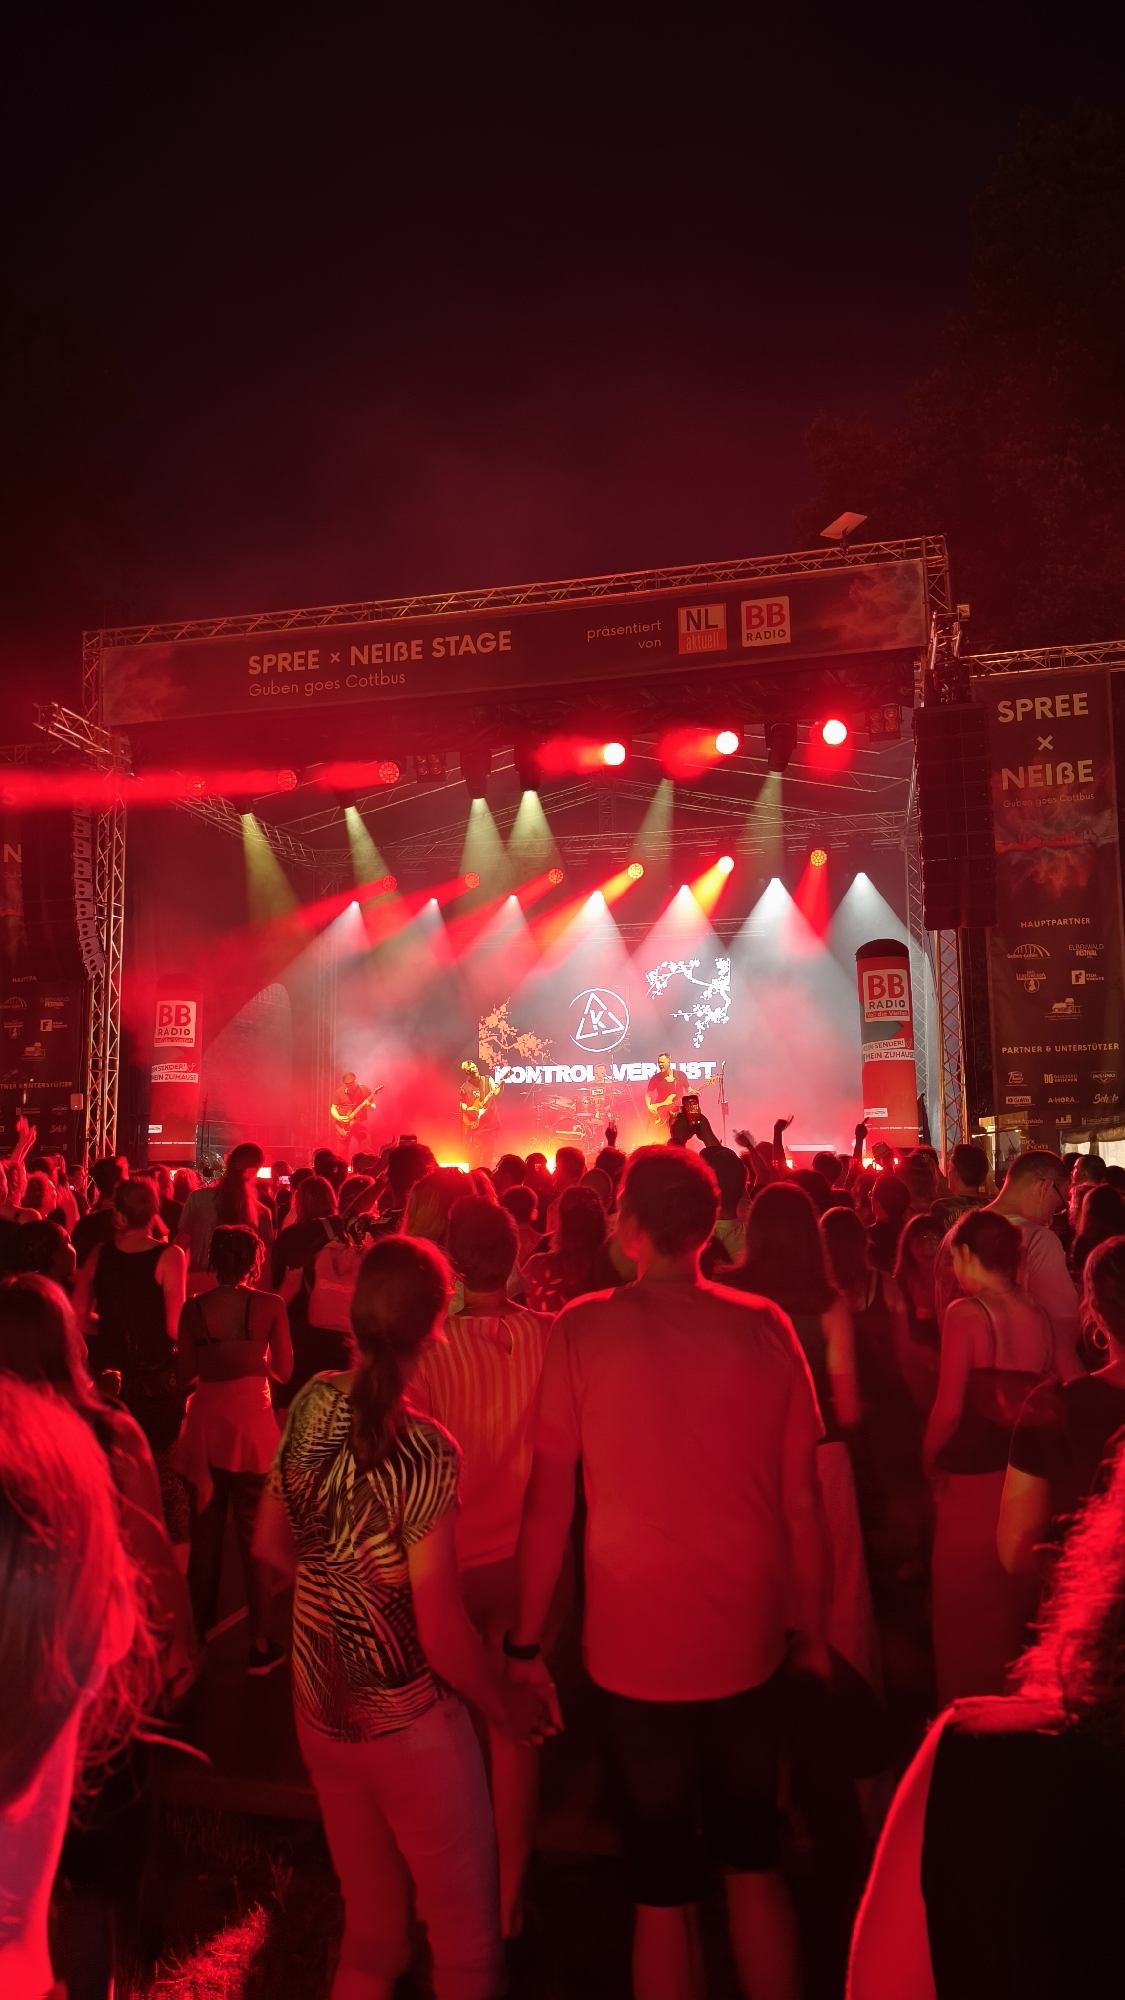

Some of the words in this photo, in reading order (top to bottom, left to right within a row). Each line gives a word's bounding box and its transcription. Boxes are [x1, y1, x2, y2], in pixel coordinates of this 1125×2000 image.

[686, 608, 718, 631] NL
[745, 603, 786, 630] BB
[587, 620, 661, 642] präsentiert
[746, 629, 786, 641] RADIO
[638, 639, 661, 649] von
[686, 632, 719, 651] aktuell
[248, 649, 320, 675] SPREE
[431, 630, 512, 657] STAGE
[249, 679, 299, 697] Guben
[304, 679, 340, 696] goes
[346, 670, 406, 688] Cottbus
[997, 693, 1089, 723] SPREE
[1003, 797, 1032, 807] Guben
[1035, 797, 1057, 807] goes
[1059, 792, 1094, 802] Cottbus
[1020, 917, 1091, 928] HAUPTPARTNER
[868, 974, 905, 999] BB
[868, 999, 906, 1010] RADIO
[159, 1005, 191, 1027] BB
[590, 1009, 607, 1031] K
[157, 1027, 191, 1036] RADIO
[874, 1039, 904, 1049] SENDER!
[1002, 1045, 1043, 1054] PARTNER
[1054, 1042, 1120, 1052] UNTERSTÜTZER
[165, 1073, 196, 1081] ZUHAUSE
